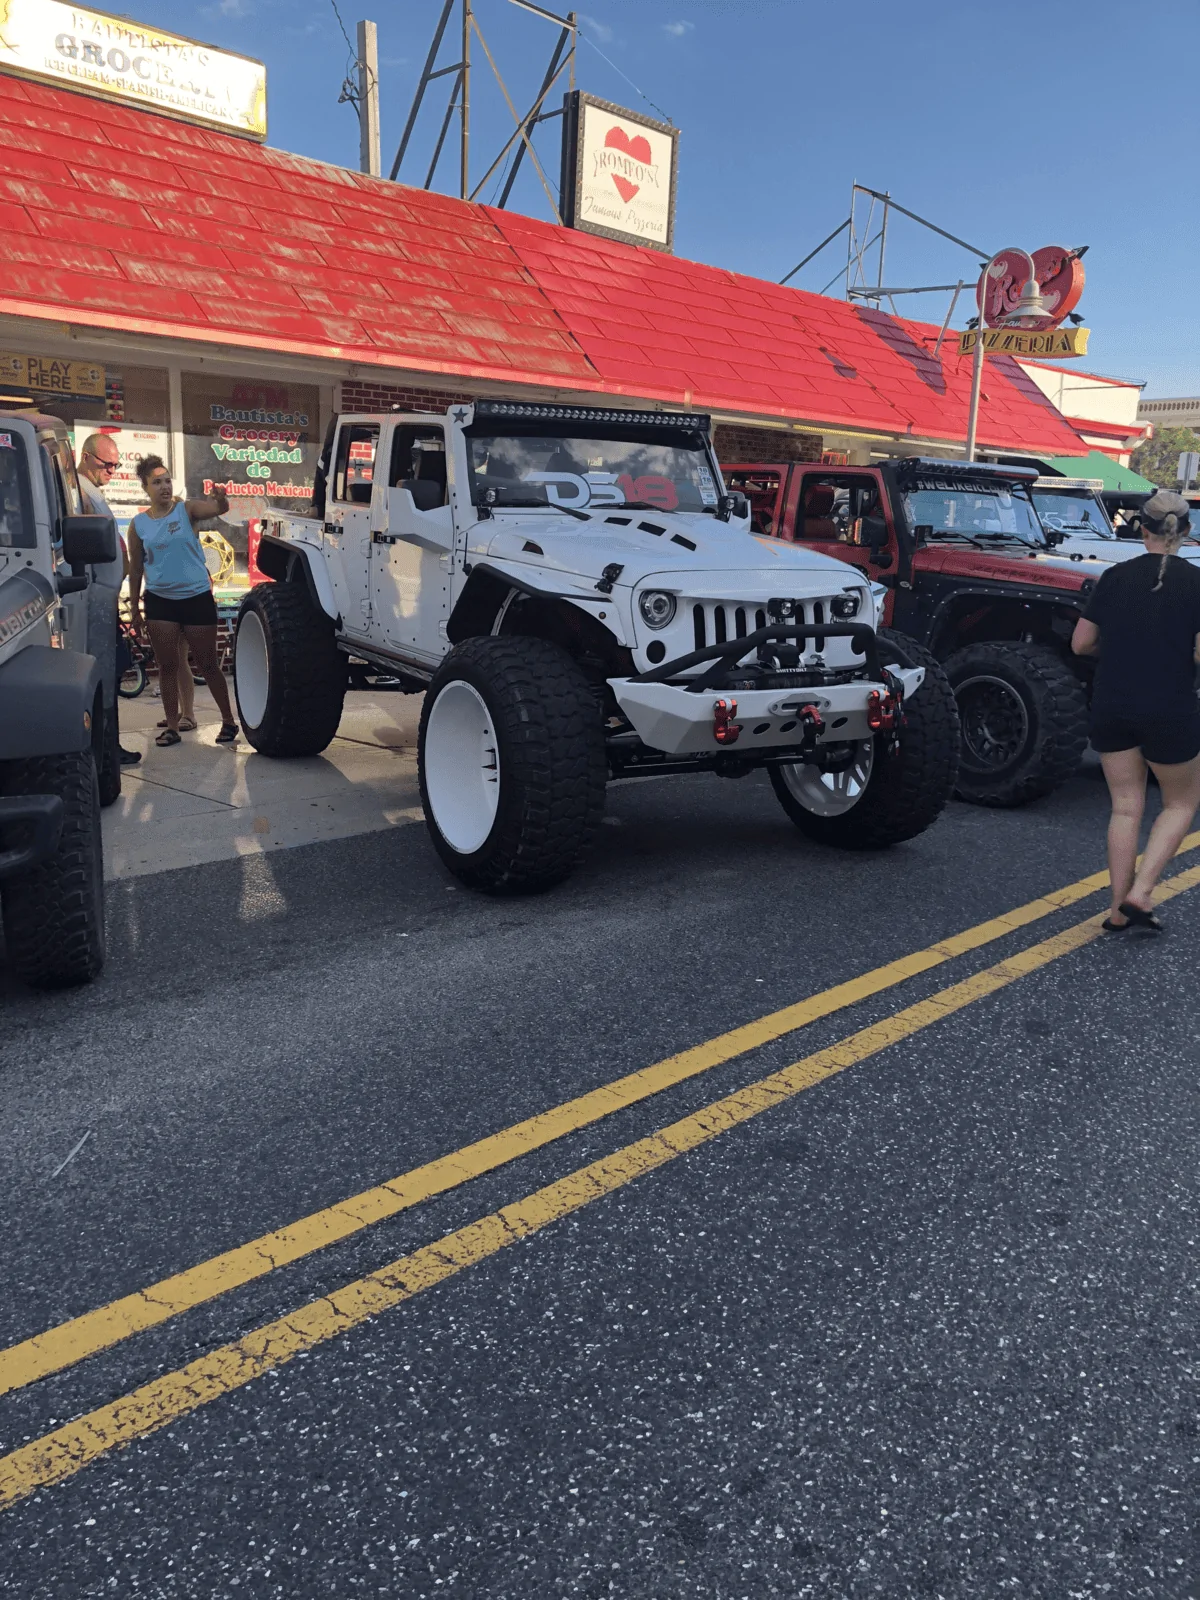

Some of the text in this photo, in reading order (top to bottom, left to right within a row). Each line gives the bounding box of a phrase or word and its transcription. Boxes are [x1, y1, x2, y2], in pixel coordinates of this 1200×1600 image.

[600, 154, 654, 184] ROMEO'S
[584, 196, 663, 233] Famous Pizzeria
[27, 358, 72, 376] PLAY
[28, 374, 72, 390] HERE
[210, 404, 308, 426] Bautista's
[219, 424, 301, 446] Grocery
[211, 443, 302, 463] Variedad
[246, 462, 271, 478] de
[523, 471, 679, 510] DS18
[0, 596, 44, 644] UBICON
